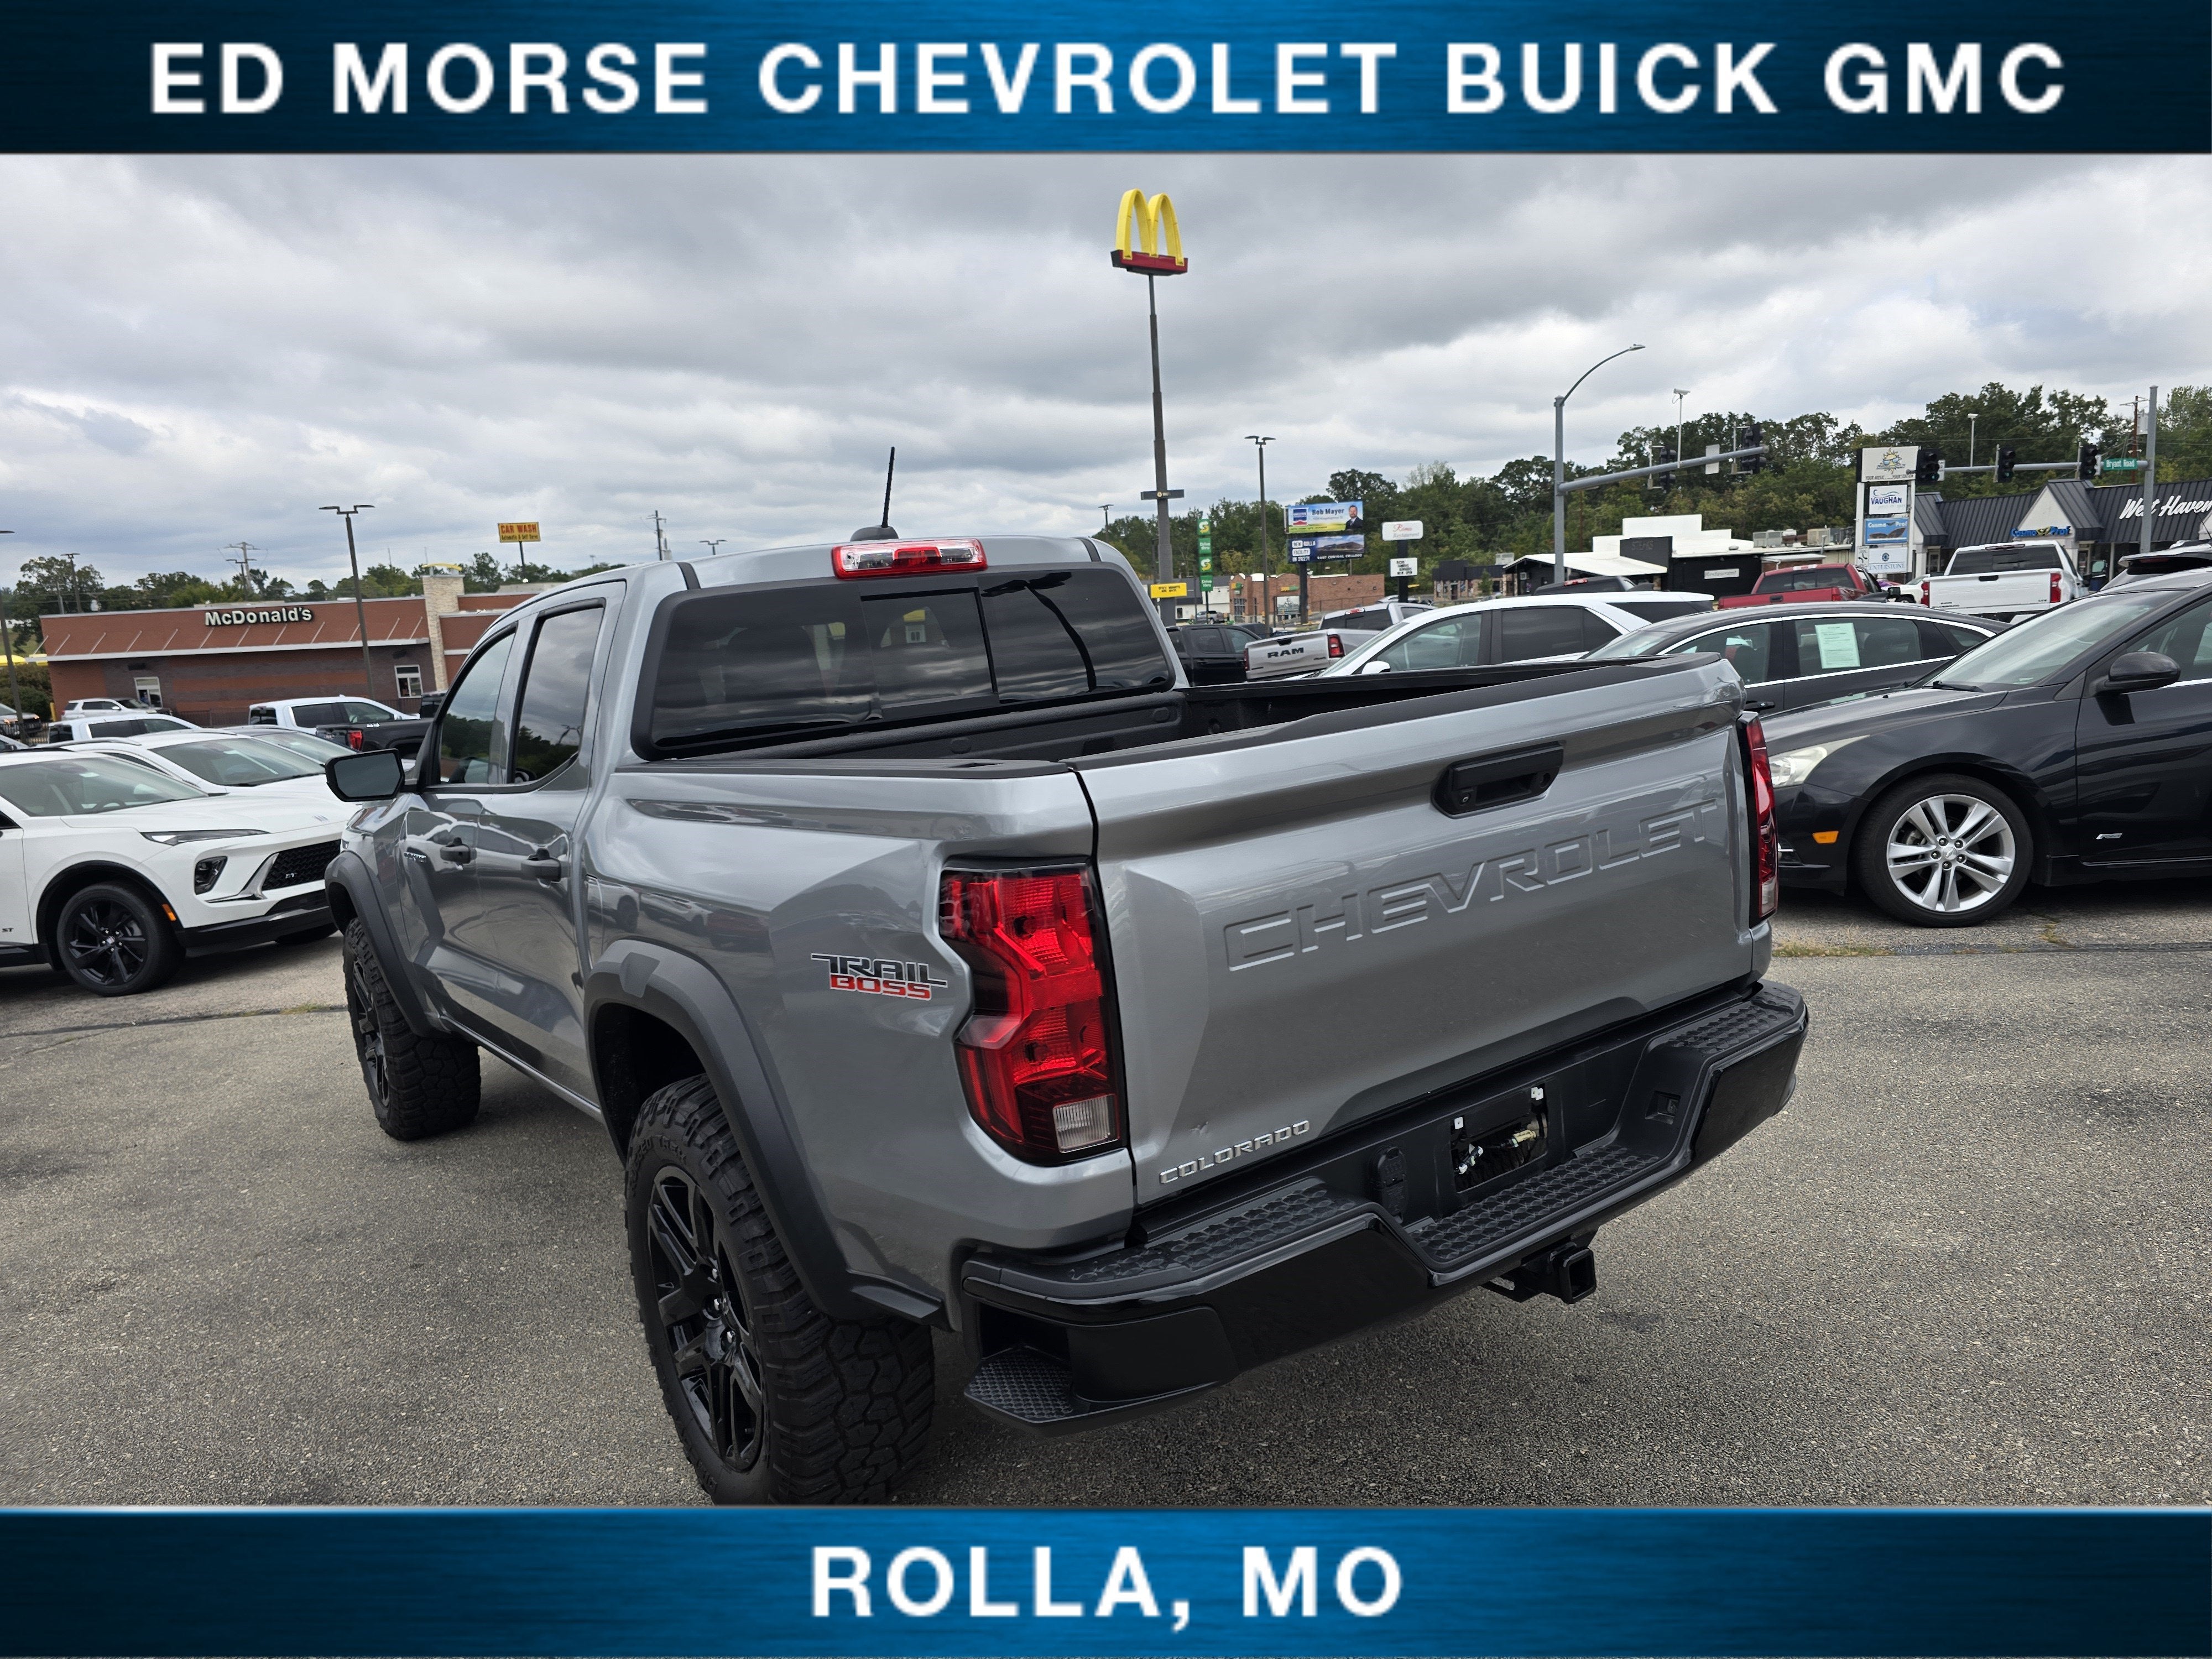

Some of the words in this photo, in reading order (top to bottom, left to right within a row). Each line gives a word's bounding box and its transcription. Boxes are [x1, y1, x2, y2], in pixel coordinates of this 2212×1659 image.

[2106, 460, 2122, 469] Bryant
[1870, 497, 1902, 505] VAUGHAN
[2119, 498, 2161, 519] Wet
[500, 525, 515, 534] CAR
[517, 524, 536, 534] WASH
[2011, 527, 2037, 536] Cosmo
[2049, 525, 2071, 535] Prof
[205, 607, 312, 626] McDonald's
[1267, 646, 1304, 658] RAM
[1224, 799, 1719, 972] CHEVROLET
[811, 953, 948, 988] TRAIL
[830, 973, 931, 1001] BOSS
[1160, 1119, 1310, 1185] COLORADO
